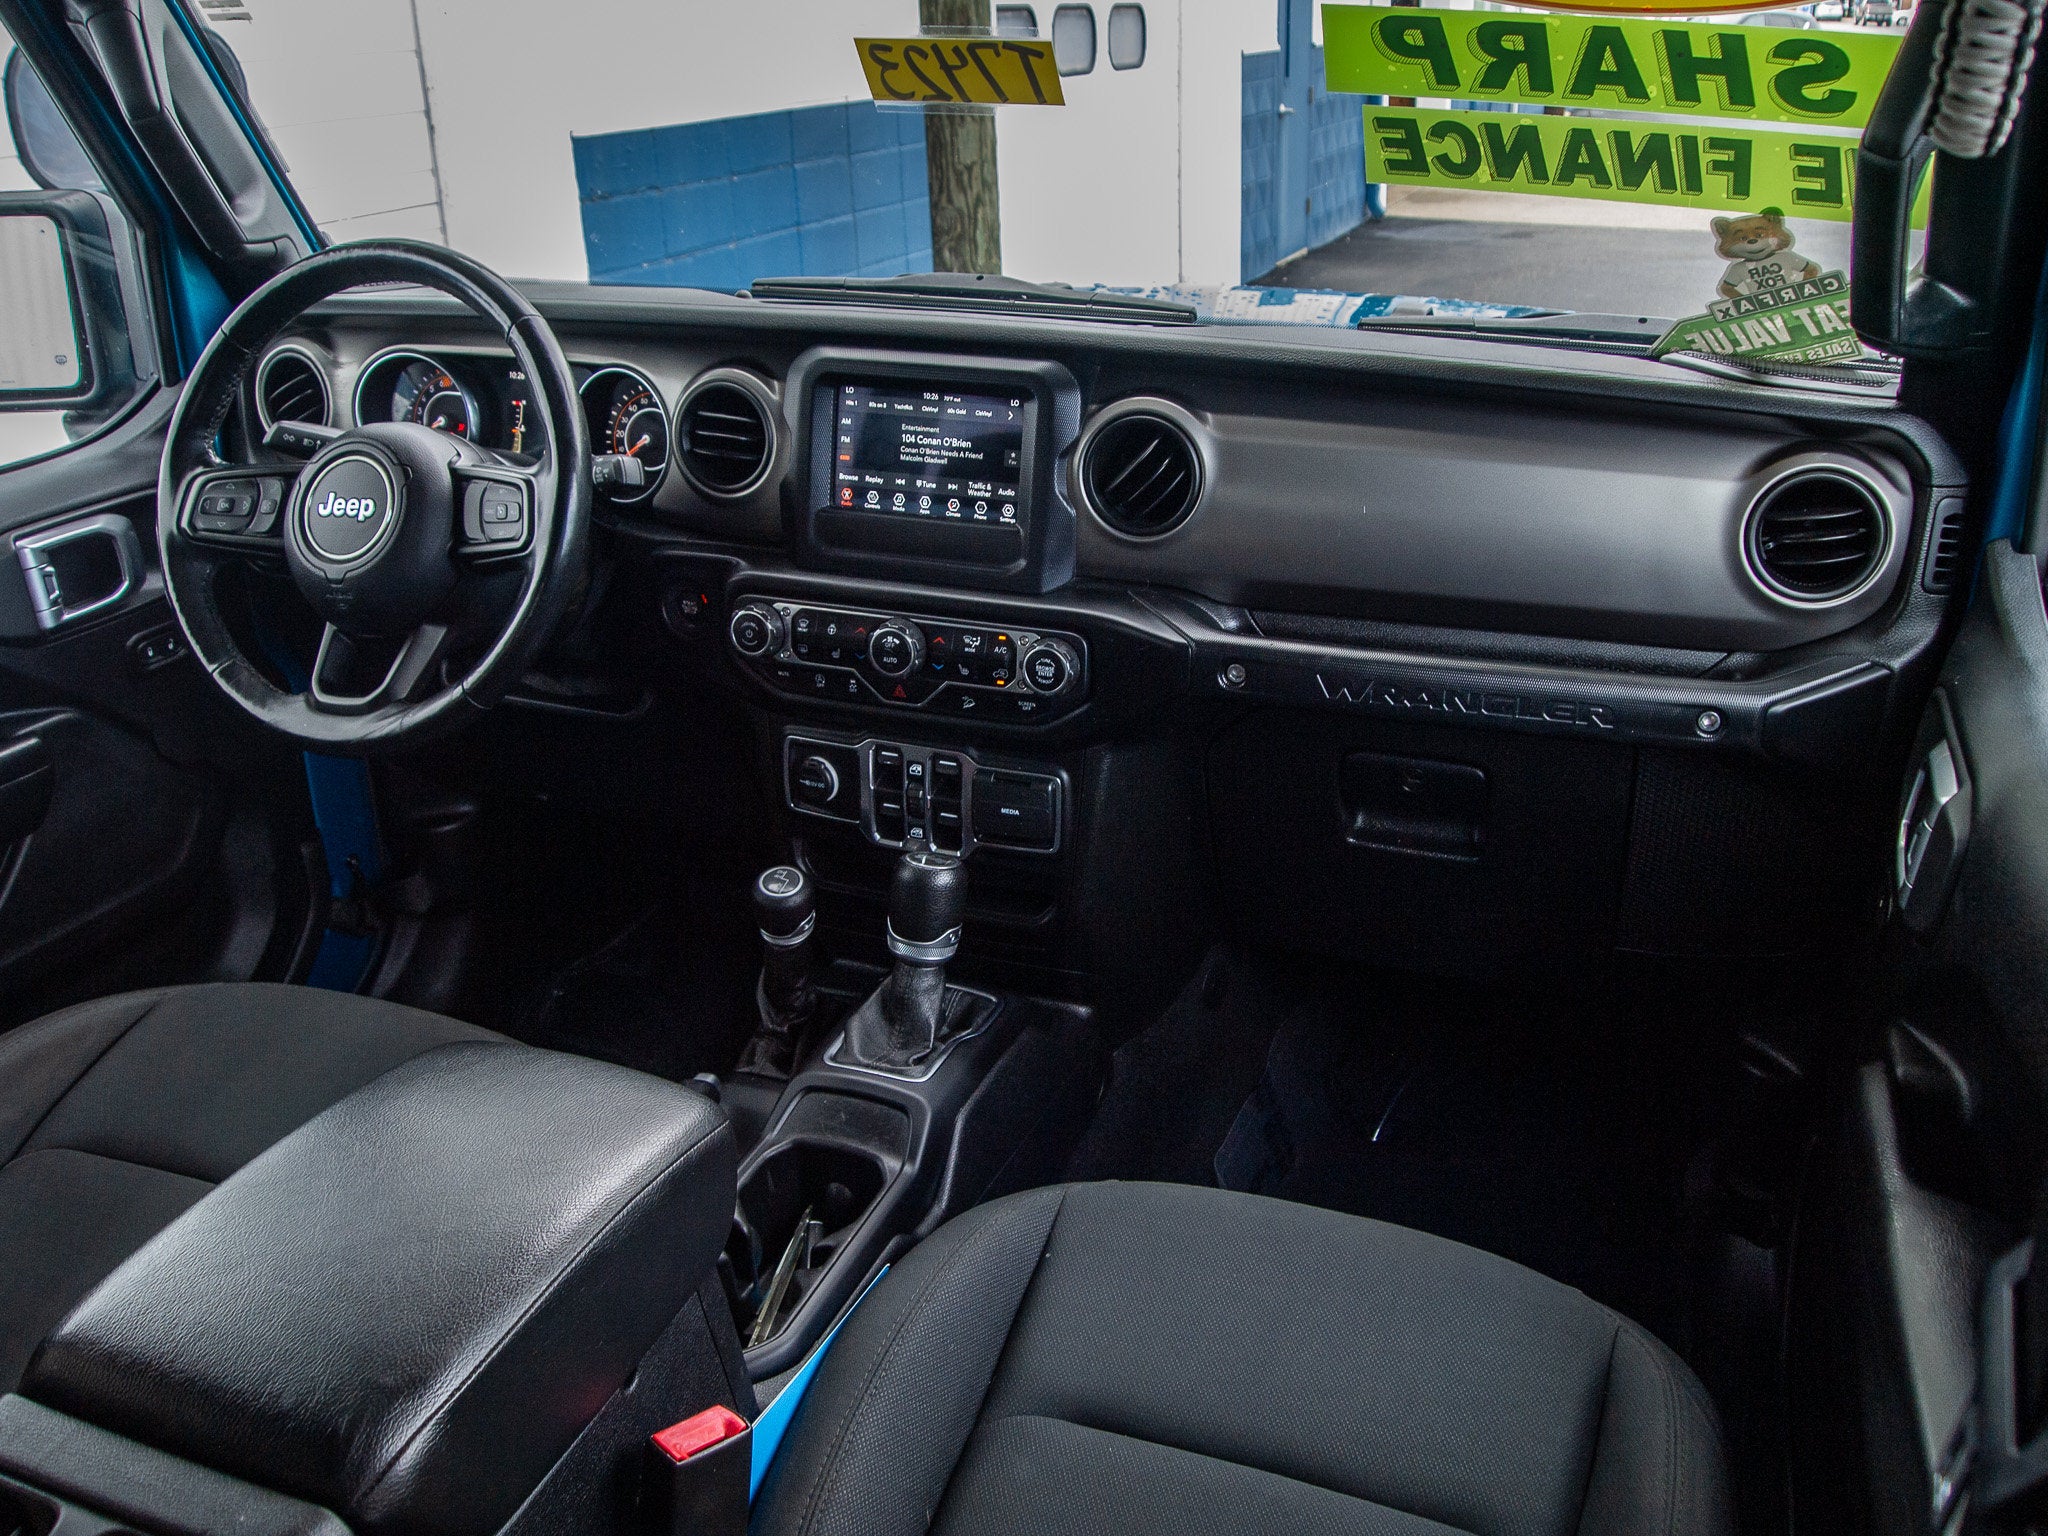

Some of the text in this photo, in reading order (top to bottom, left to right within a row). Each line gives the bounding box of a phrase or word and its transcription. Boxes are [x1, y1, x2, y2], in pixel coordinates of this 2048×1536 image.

[509, 371, 526, 380] 10:26
[845, 386, 855, 394] LO
[923, 392, 939, 400] 10:26
[1010, 399, 1020, 407] LO
[901, 423, 940, 433] Entertainment
[615, 429, 624, 438] 20
[840, 435, 851, 443] FM
[901, 433, 972, 448] 104 Conan O'Brien
[919, 447, 940, 456] O'Brien
[940, 449, 959, 457] Needs
[965, 451, 983, 459] Friend
[900, 454, 948, 464] Malcolm Gladwell
[838, 472, 859, 481] Browse
[865, 475, 884, 485] Replay
[923, 480, 937, 489] Tune
[968, 481, 986, 490] Traffic
[967, 489, 992, 498] Weather
[997, 488, 1015, 496] Audio
[316, 491, 377, 522] Jeep
[993, 646, 1007, 654] A/C
[1316, 673, 1614, 729] WRANGLER
[1000, 807, 1020, 816] MEDIA
